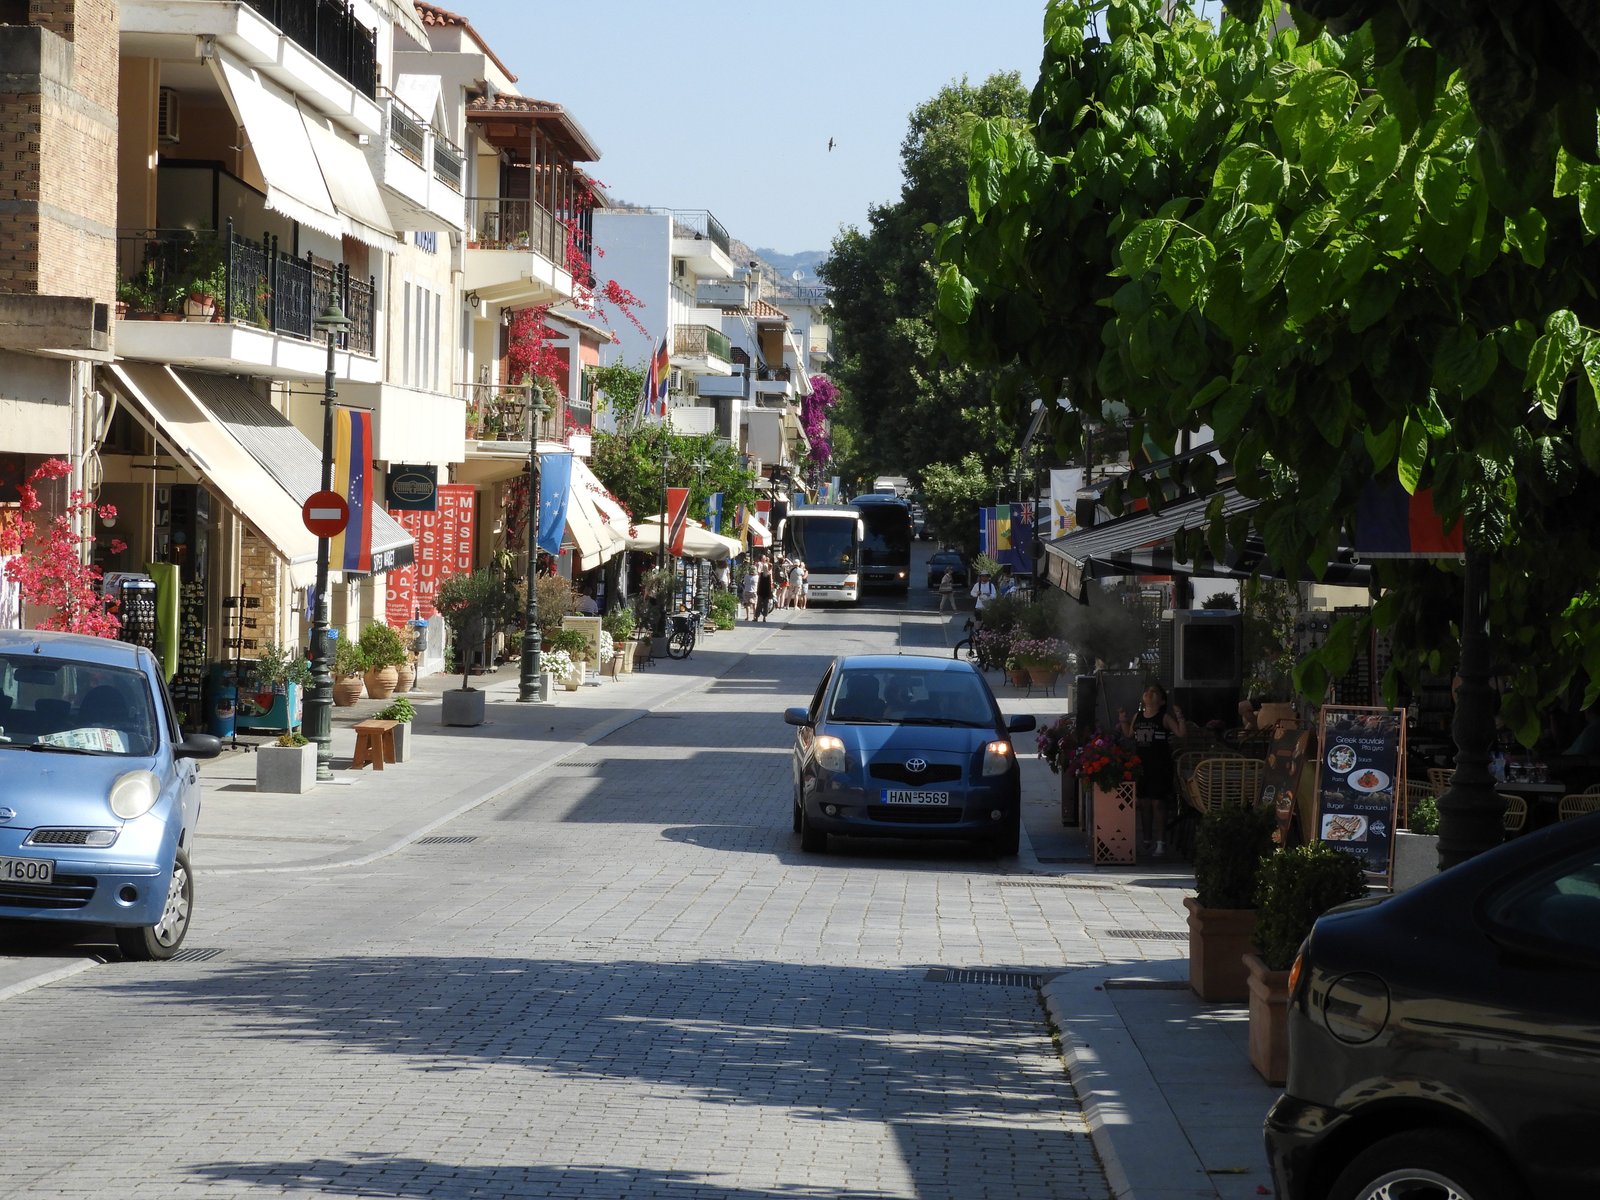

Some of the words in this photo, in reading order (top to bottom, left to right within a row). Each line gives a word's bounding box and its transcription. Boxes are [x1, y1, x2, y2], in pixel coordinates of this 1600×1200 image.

[420, 514, 434, 593] USEUM
[458, 497, 472, 577] MUSEU
[1336, 736, 1357, 745] Greek
